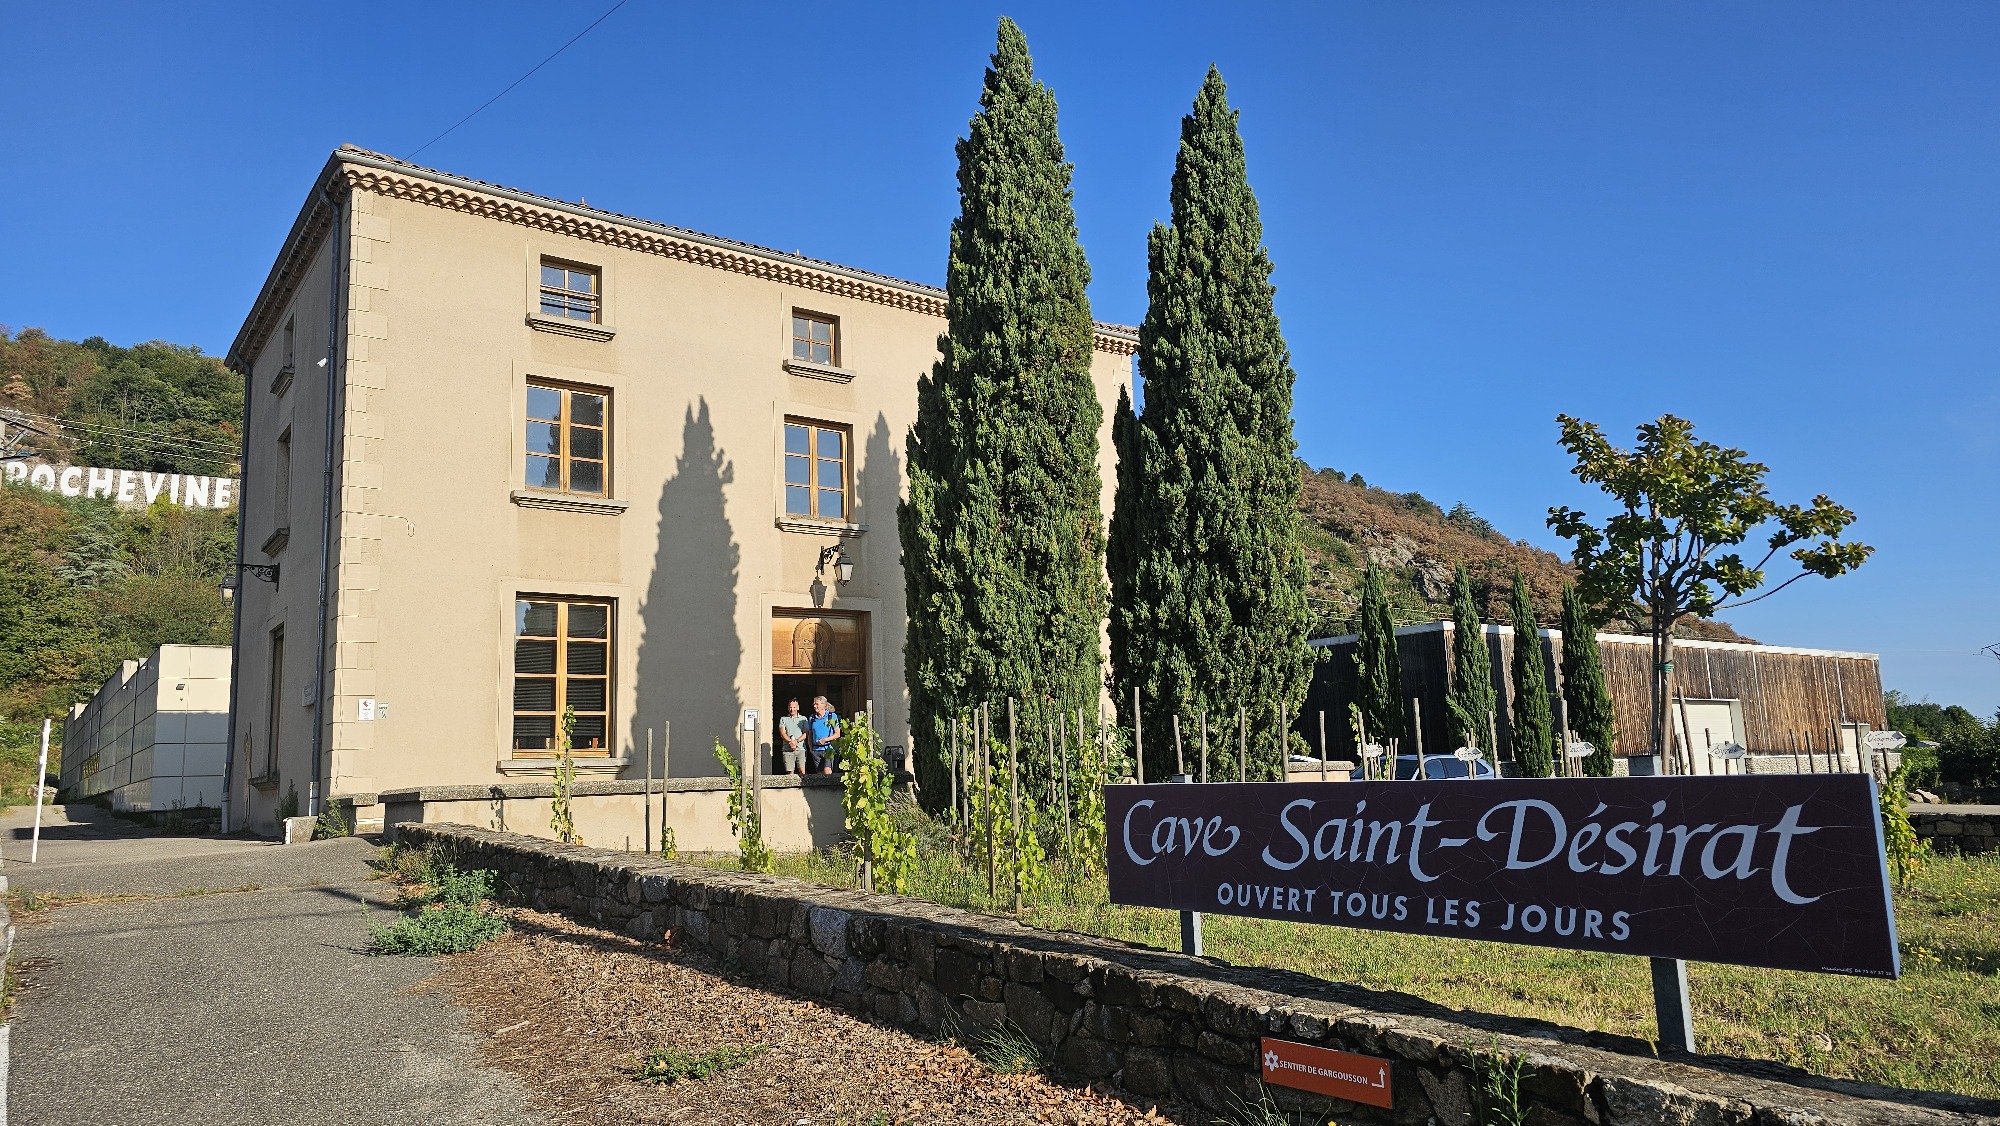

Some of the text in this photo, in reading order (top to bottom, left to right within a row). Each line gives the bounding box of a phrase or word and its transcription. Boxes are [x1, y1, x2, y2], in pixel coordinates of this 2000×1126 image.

[1123, 799, 1823, 905] Cave Saint-Désirat
[1217, 882, 1631, 941] OUVERT TOUS LES JOURS
[1280, 1060, 1368, 1085] SENTIER DE GARGOUSSON
